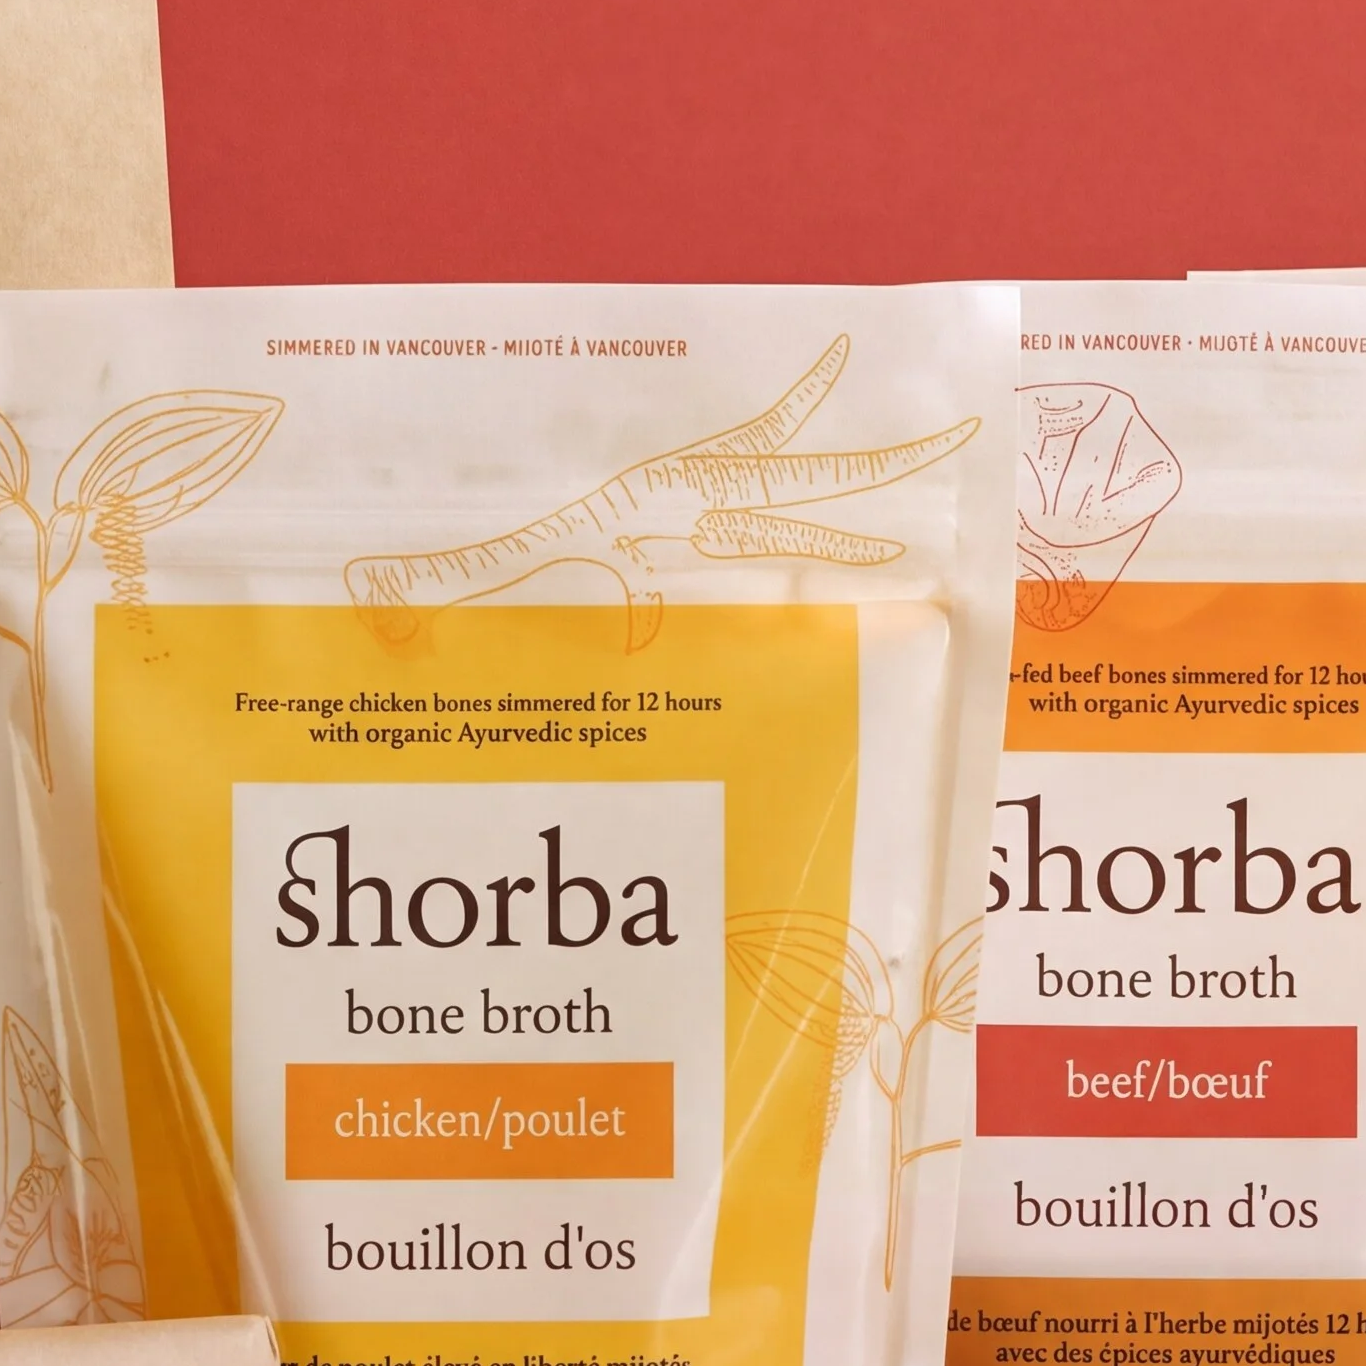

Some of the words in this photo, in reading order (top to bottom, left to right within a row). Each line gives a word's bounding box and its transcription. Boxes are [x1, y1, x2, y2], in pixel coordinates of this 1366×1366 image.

[266, 339, 356, 356] SIMMERED
[362, 339, 380, 356] IN
[386, 339, 486, 357] VANCOUVER
[586, 339, 687, 357] VANCOUVER
[1058, 334, 1075, 351] IN
[1081, 333, 1181, 352] VANCOUVER
[1058, 662, 1104, 684] beef
[1108, 663, 1167, 685] bones
[1172, 665, 1269, 685] simmered
[1274, 664, 1304, 685] for
[1309, 665, 1331, 685] 12
[235, 692, 344, 719] Free-range
[349, 691, 428, 713] chicken
[433, 692, 492, 713] bones
[497, 691, 596, 712] simmered
[601, 690, 632, 712] for
[637, 691, 660, 712] 12
[664, 690, 722, 712] hours
[1028, 690, 1078, 713] with
[1083, 693, 1169, 720] organic
[1173, 692, 1287, 720] Ayurvedic
[1292, 693, 1360, 721] spices
[308, 720, 360, 743] with
[365, 721, 452, 750] organic
[457, 719, 573, 750] Ayurvedic
[578, 720, 647, 748] spices
[276, 824, 679, 949] shorba
[1035, 952, 1152, 999] bone
[1168, 953, 1298, 999] broth
[344, 987, 465, 1035] bone
[480, 986, 613, 1034] broth
[1065, 1058, 1273, 1102] beef/bœuf
[334, 1096, 626, 1150] chicken/poulet
[1013, 1180, 1211, 1228] bouillon
[324, 1222, 528, 1271] bouillon
[977, 1309, 1042, 1333] bœuf
[1044, 1312, 1119, 1334] nourri
[1125, 1310, 1138, 1334] à
[1233, 1312, 1319, 1340] mijotés
[1326, 1313, 1351, 1335] 12
[995, 1347, 1048, 1363] avec
[1053, 1340, 1093, 1364] des
